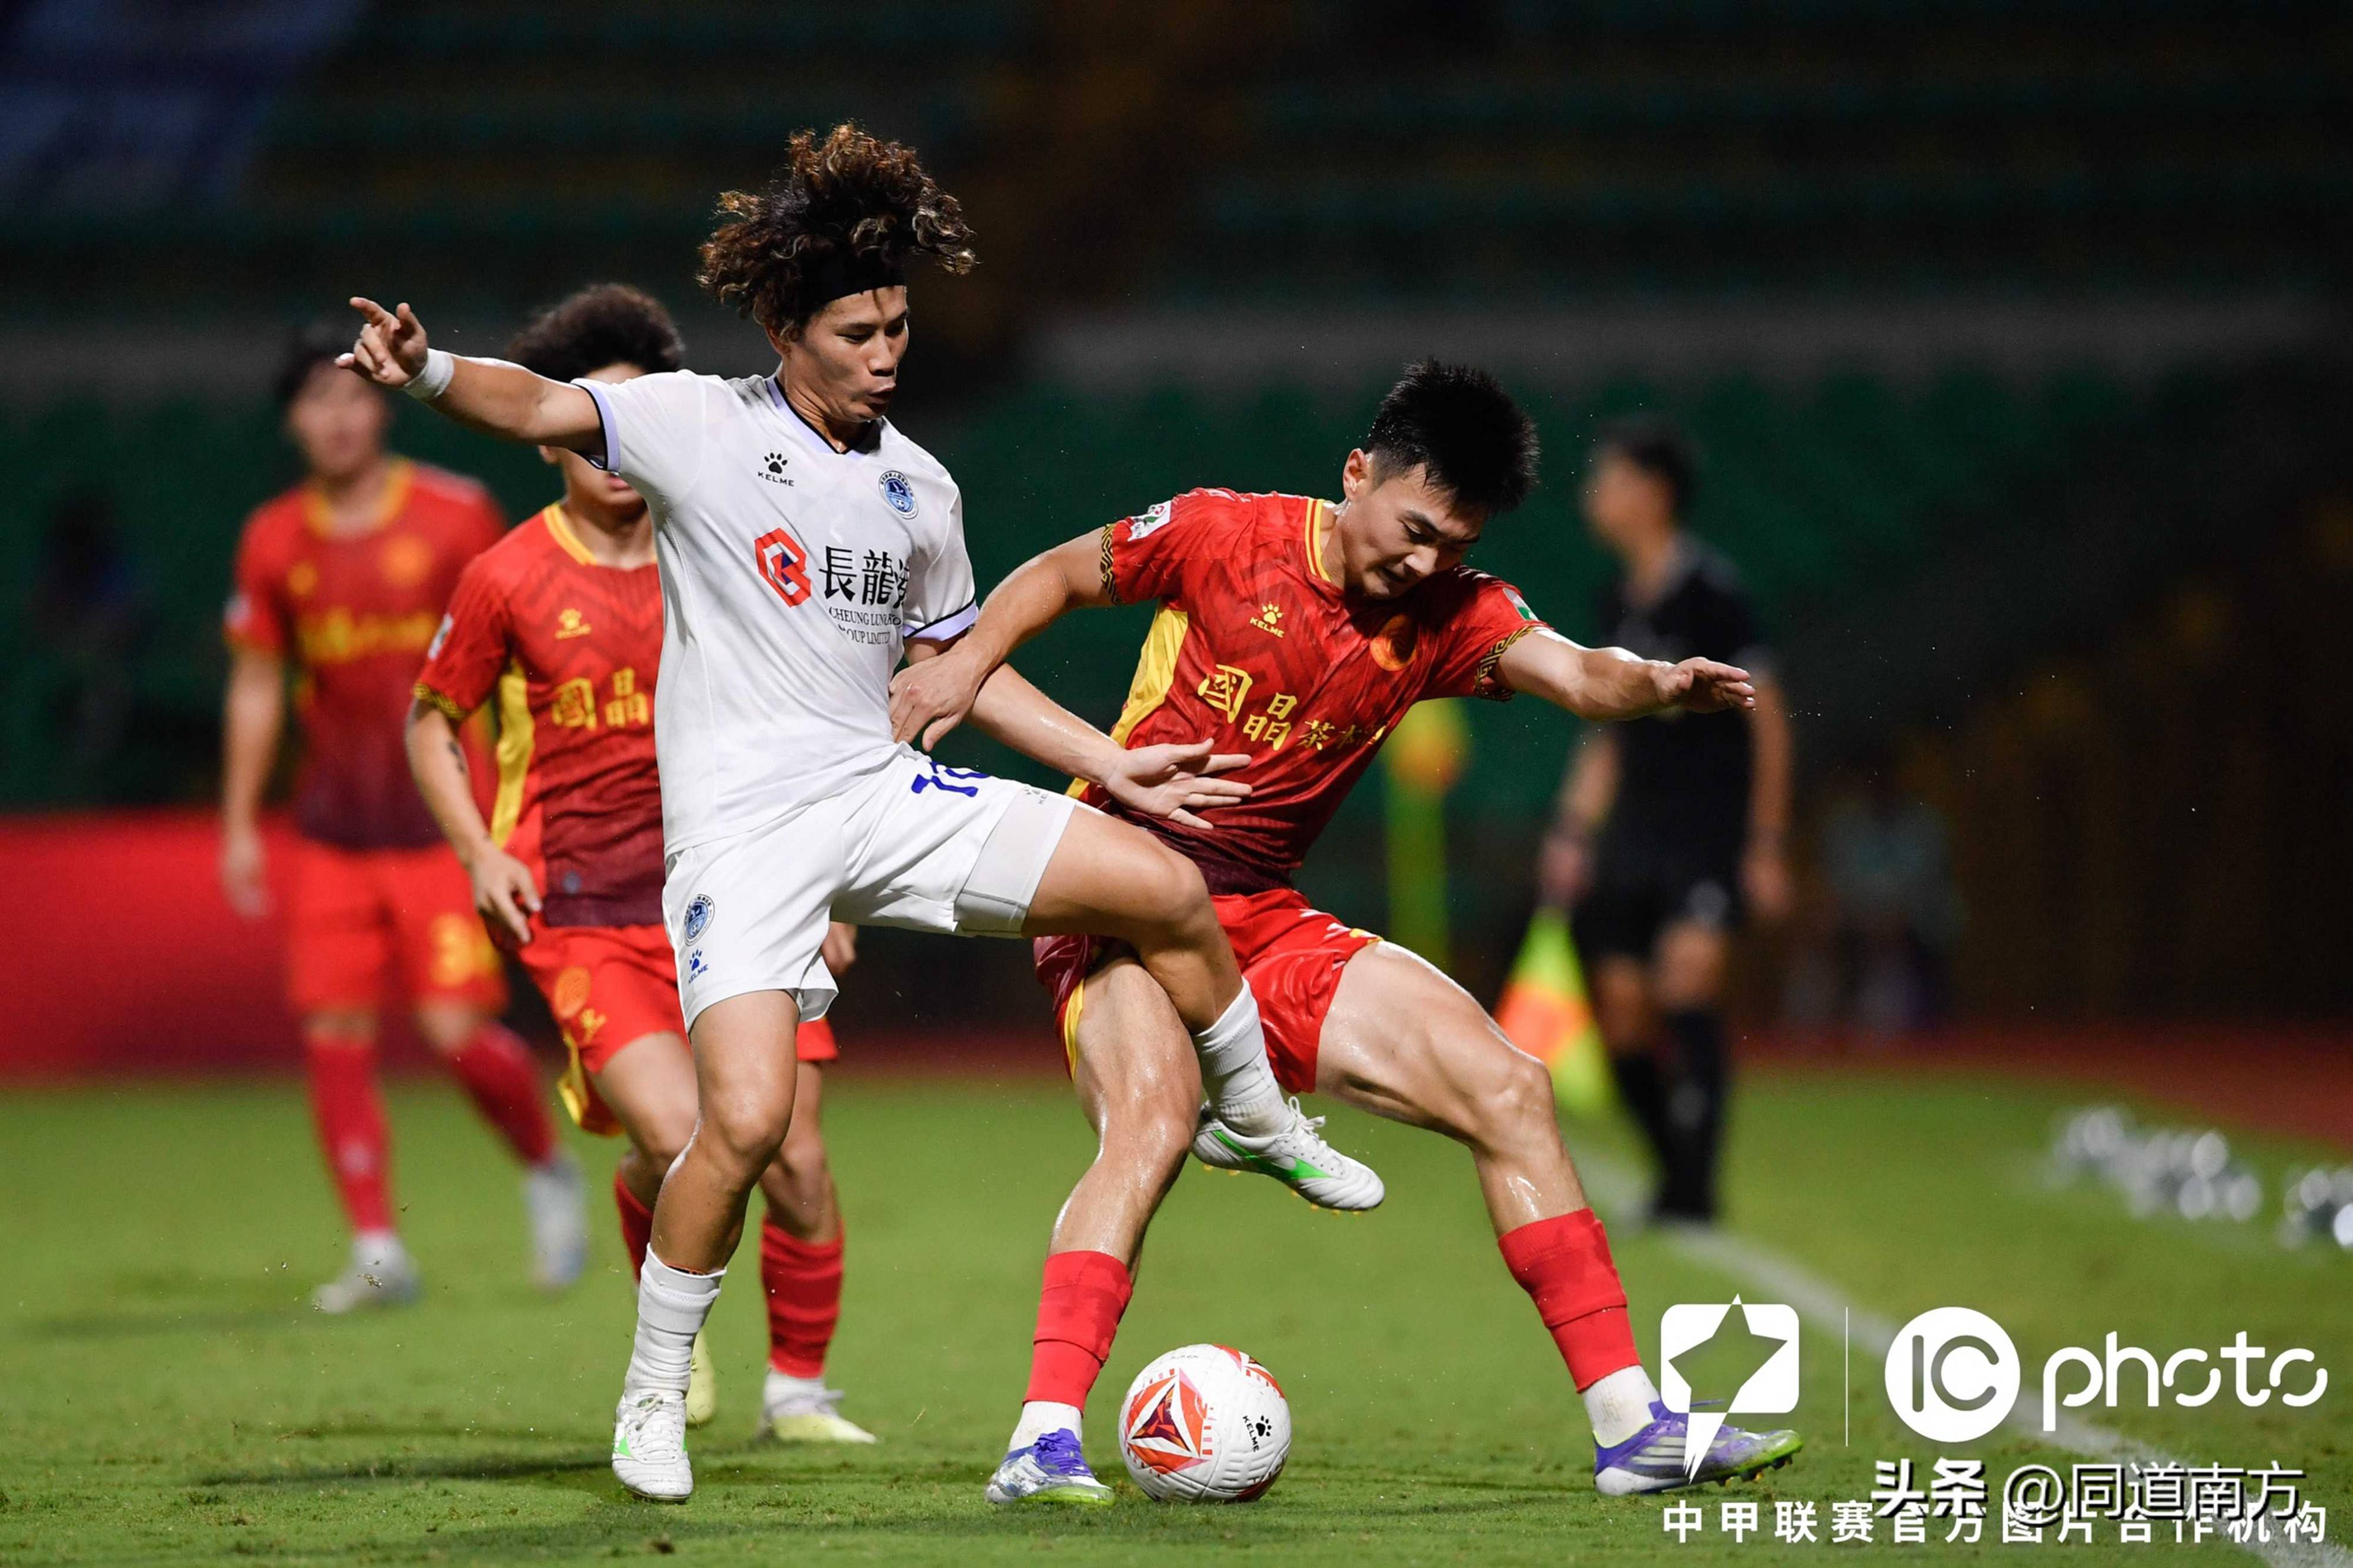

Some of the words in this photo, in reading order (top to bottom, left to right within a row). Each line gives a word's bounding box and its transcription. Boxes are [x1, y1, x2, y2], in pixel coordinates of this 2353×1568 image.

[758, 471, 794, 486] KELME
[829, 606, 869, 625] CHEUNG
[1249, 617, 1284, 638] KELME
[1242, 1415, 1260, 1452] KELME
